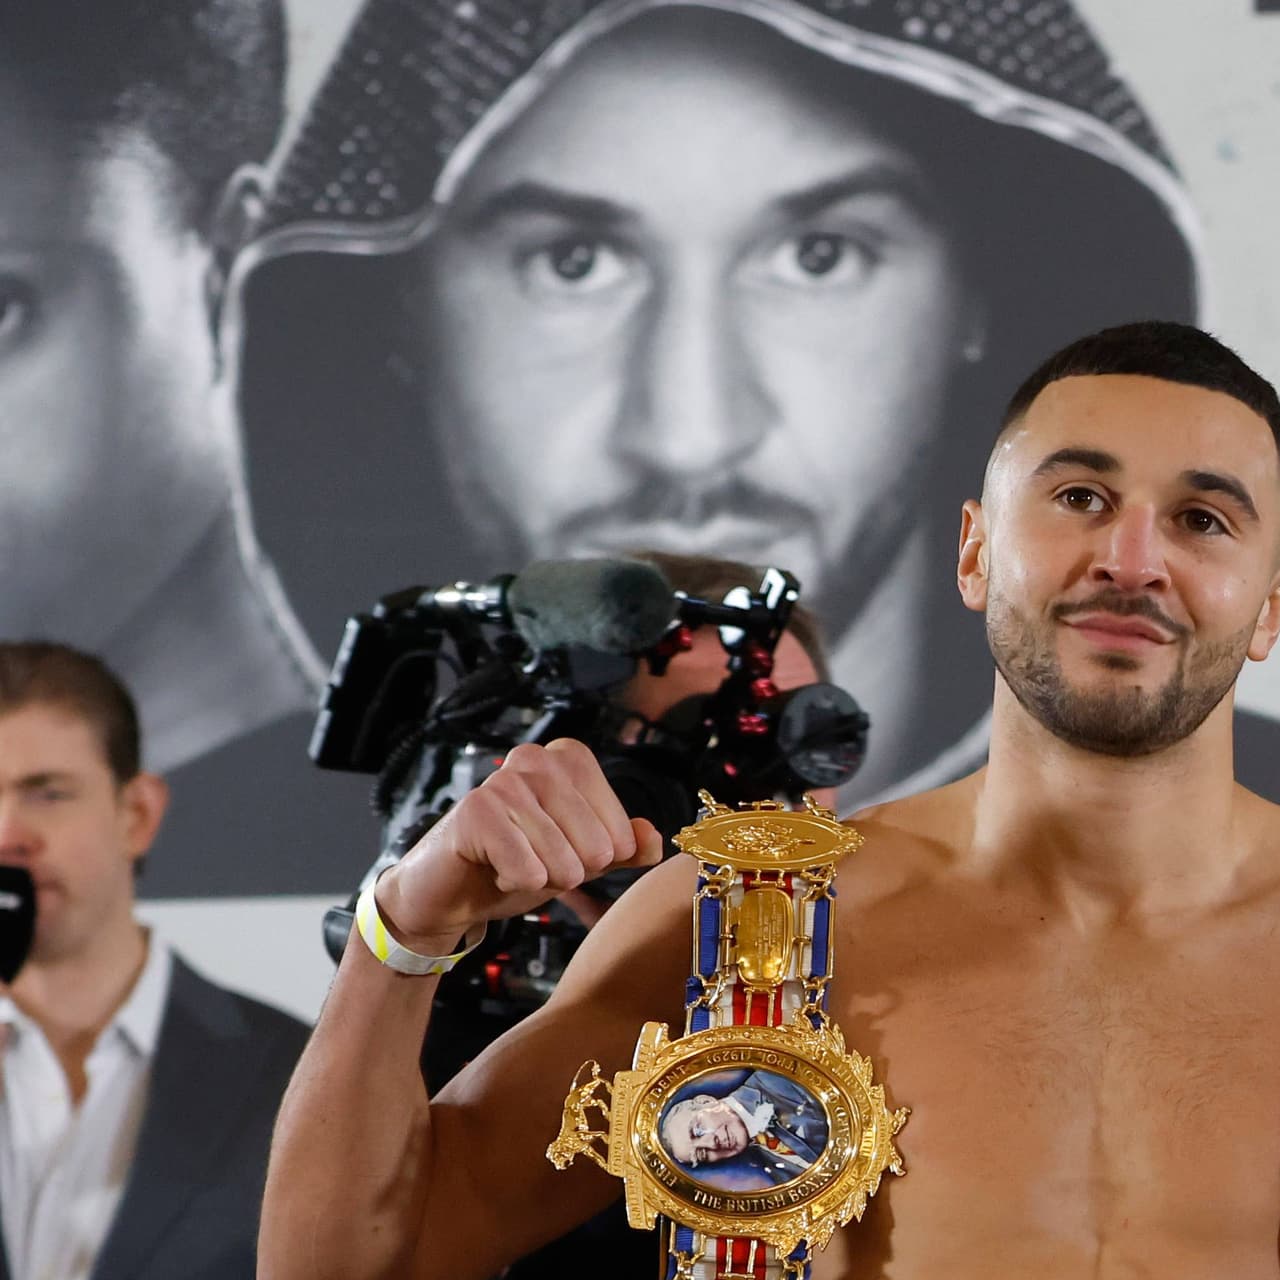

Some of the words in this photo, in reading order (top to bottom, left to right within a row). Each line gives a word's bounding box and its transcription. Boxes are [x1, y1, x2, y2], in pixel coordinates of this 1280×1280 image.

[642, 1146, 679, 1188] FIRST
[692, 1189, 724, 1210] THE
[725, 1191, 787, 1213] BRITISH
